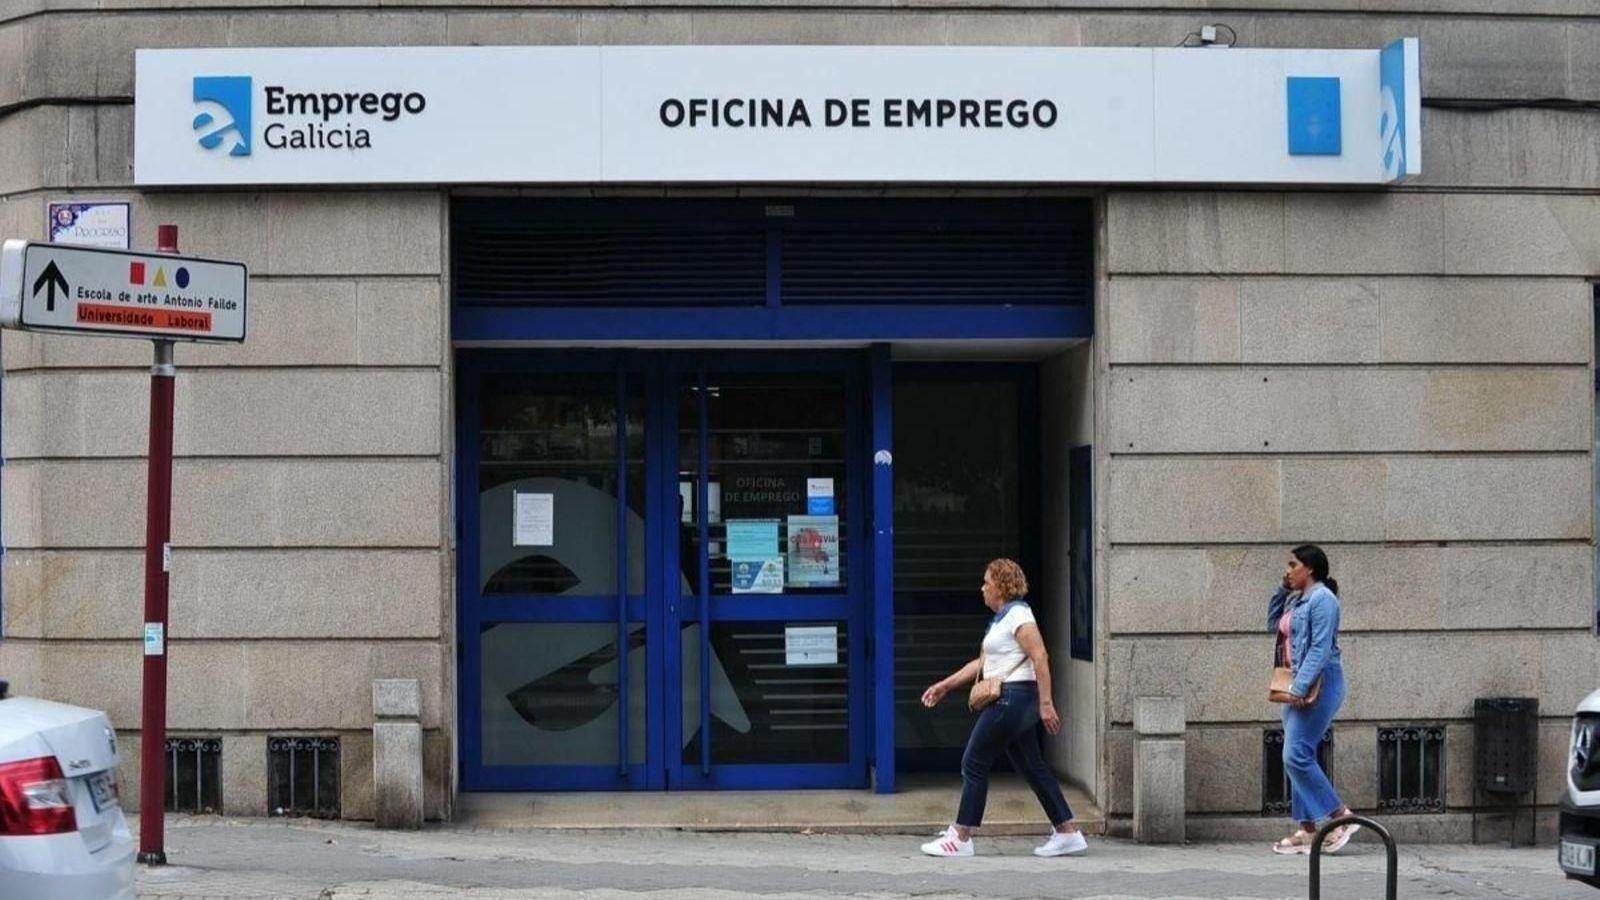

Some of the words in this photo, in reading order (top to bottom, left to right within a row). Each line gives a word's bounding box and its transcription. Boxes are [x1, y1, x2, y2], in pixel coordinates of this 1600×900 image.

[264, 86, 426, 121] Emprego
[659, 98, 812, 128] OFICINA
[824, 98, 871, 128] DE
[883, 98, 1058, 128] EMPREGO
[264, 123, 372, 149] Galicia
[77, 286, 112, 300] Escola
[118, 290, 130, 302] de
[137, 292, 158, 304] arte
[164, 294, 203, 308] Antonio
[78, 307, 154, 324] Universidade
[168, 314, 210, 330] Laboral
[736, 477, 785, 489] OFICINA
[725, 491, 741, 503] DE
[743, 491, 800, 503] EMPREGO
